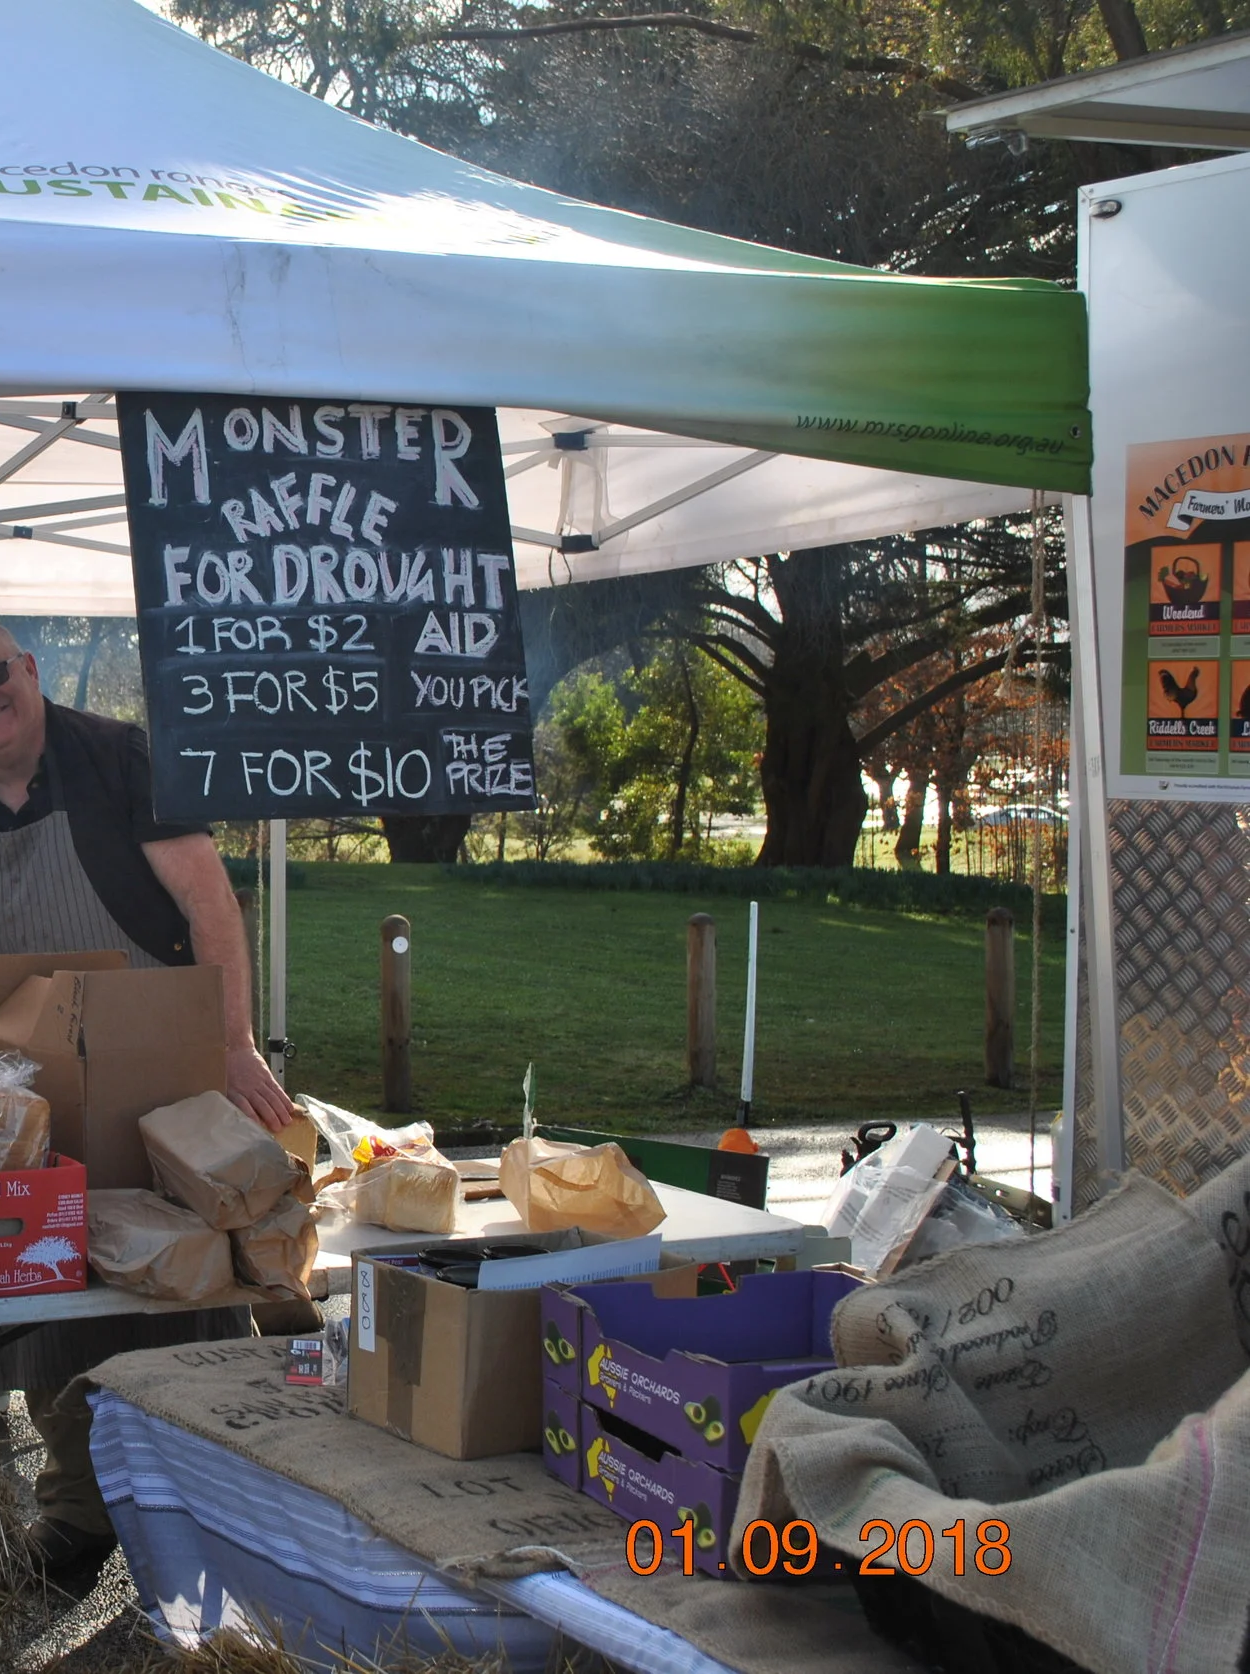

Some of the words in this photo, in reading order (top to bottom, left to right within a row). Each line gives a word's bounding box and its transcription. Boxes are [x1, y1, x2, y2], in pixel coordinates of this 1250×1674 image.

[145, 404, 483, 510] MONSTER
[1138, 444, 1235, 521] MACEDON
[220, 472, 399, 546] RAFFLE
[163, 544, 264, 608] FOR
[271, 544, 510, 610] DROUGHT
[175, 617, 207, 655] 1
[213, 615, 292, 653] FOR
[307, 613, 376, 654] $2
[413, 610, 500, 659] AID
[1162, 604, 1205, 620] Woodend
[182, 674, 215, 715] 3
[222, 670, 318, 714] FOR
[322, 665, 379, 716] $5
[410, 670, 466, 711] YOU
[472, 674, 529, 714] PICK
[442, 732, 513, 763] THE
[1149, 720, 1186, 736] Riddells
[1189, 720, 1216, 735] Creek
[180, 748, 216, 796] 7
[241, 749, 341, 799] FOR
[349, 742, 432, 807] $10
[444, 762, 535, 798] PRIZE
[6, 1181, 31, 1197] Mix
[13, 1266, 43, 1284] Herbs
[599, 1358, 629, 1381] AUSSIE
[631, 1372, 681, 1405] ORCHARDS
[598, 1451, 627, 1476] AUSSIE
[628, 1468, 675, 1505] ORCHARDS
